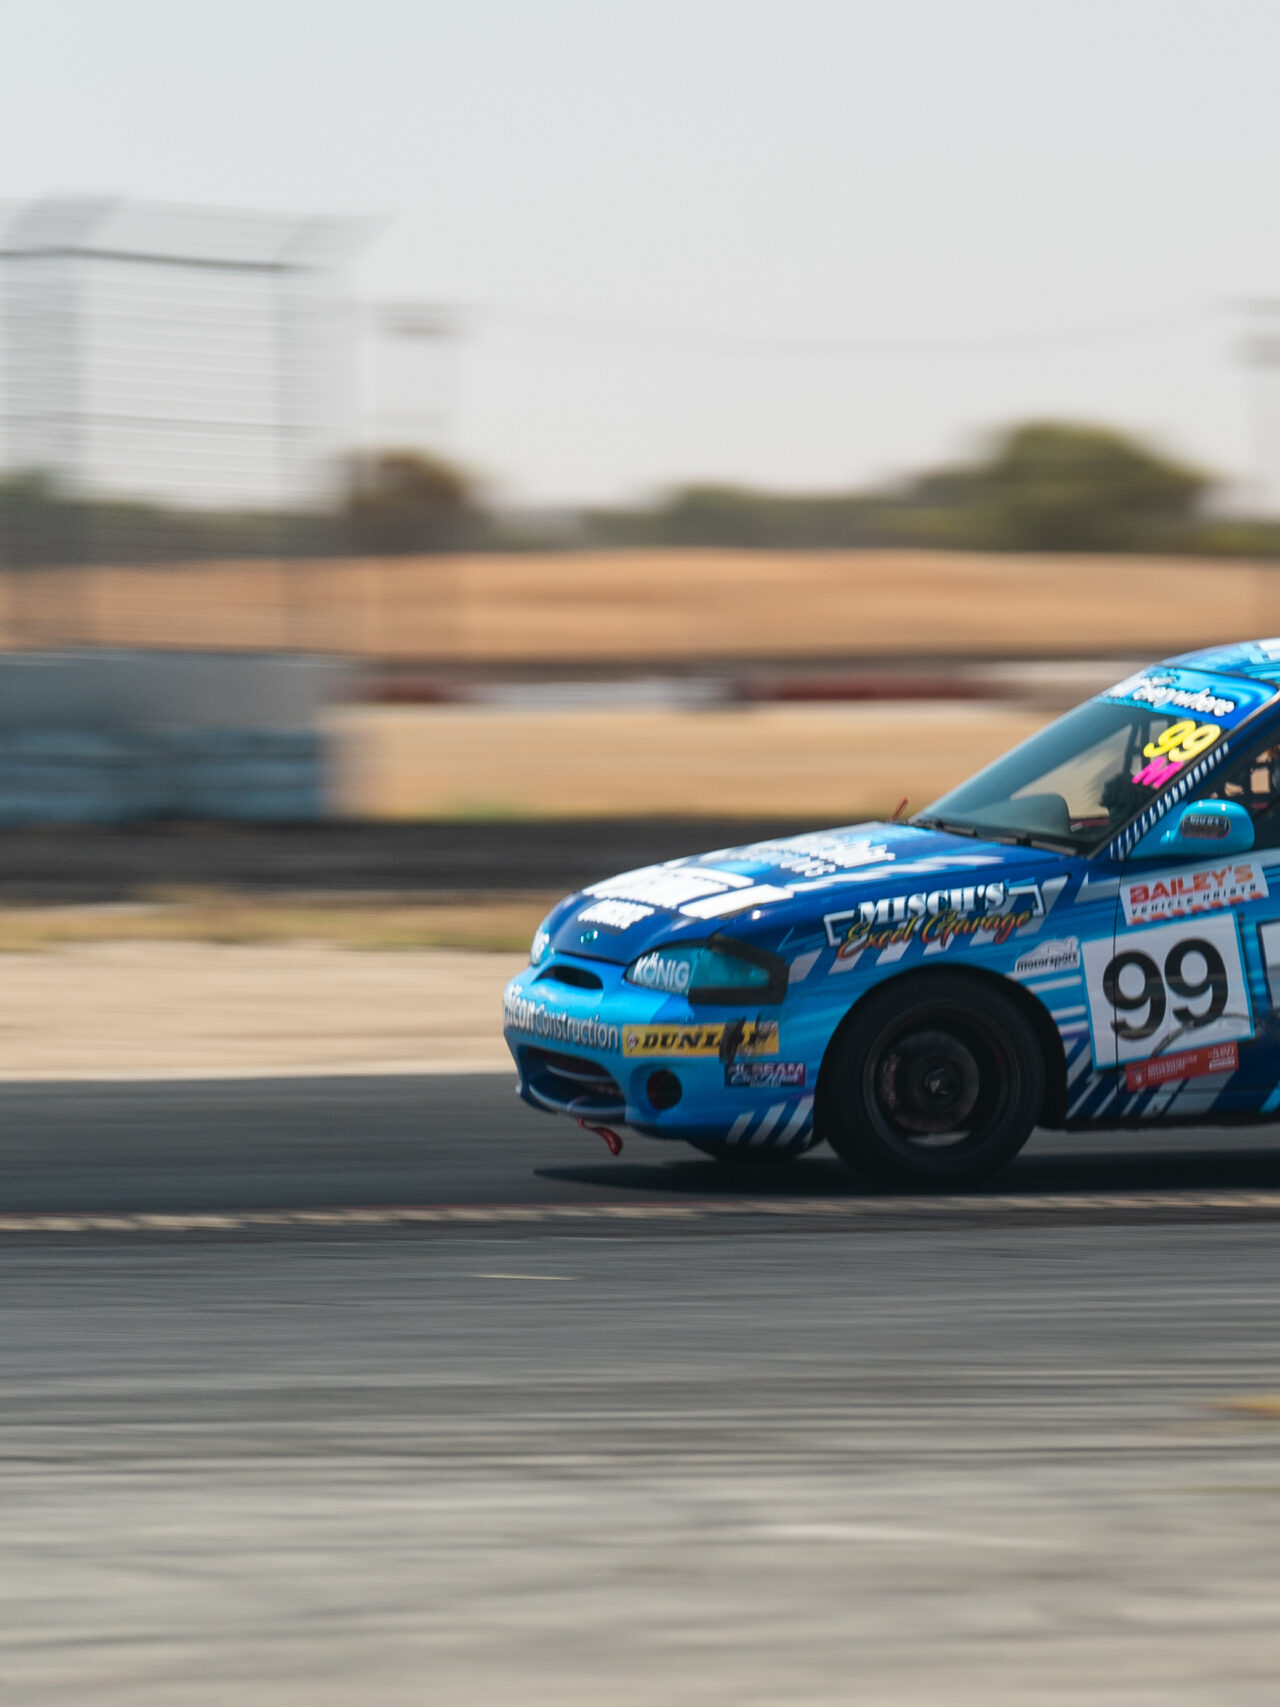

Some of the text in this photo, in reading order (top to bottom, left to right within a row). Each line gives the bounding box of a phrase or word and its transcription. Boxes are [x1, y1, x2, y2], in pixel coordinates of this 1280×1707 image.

[1143, 720, 1221, 763] 99
[858, 882, 1005, 925] MISCH'S
[1130, 864, 1254, 905] BAILEY'S
[921, 908, 1032, 946] Garage
[1017, 951, 1077, 973] motorsport
[1102, 937, 1229, 1040] 99
[535, 1002, 619, 1050] Construction
[642, 1030, 771, 1050] DUNLP
